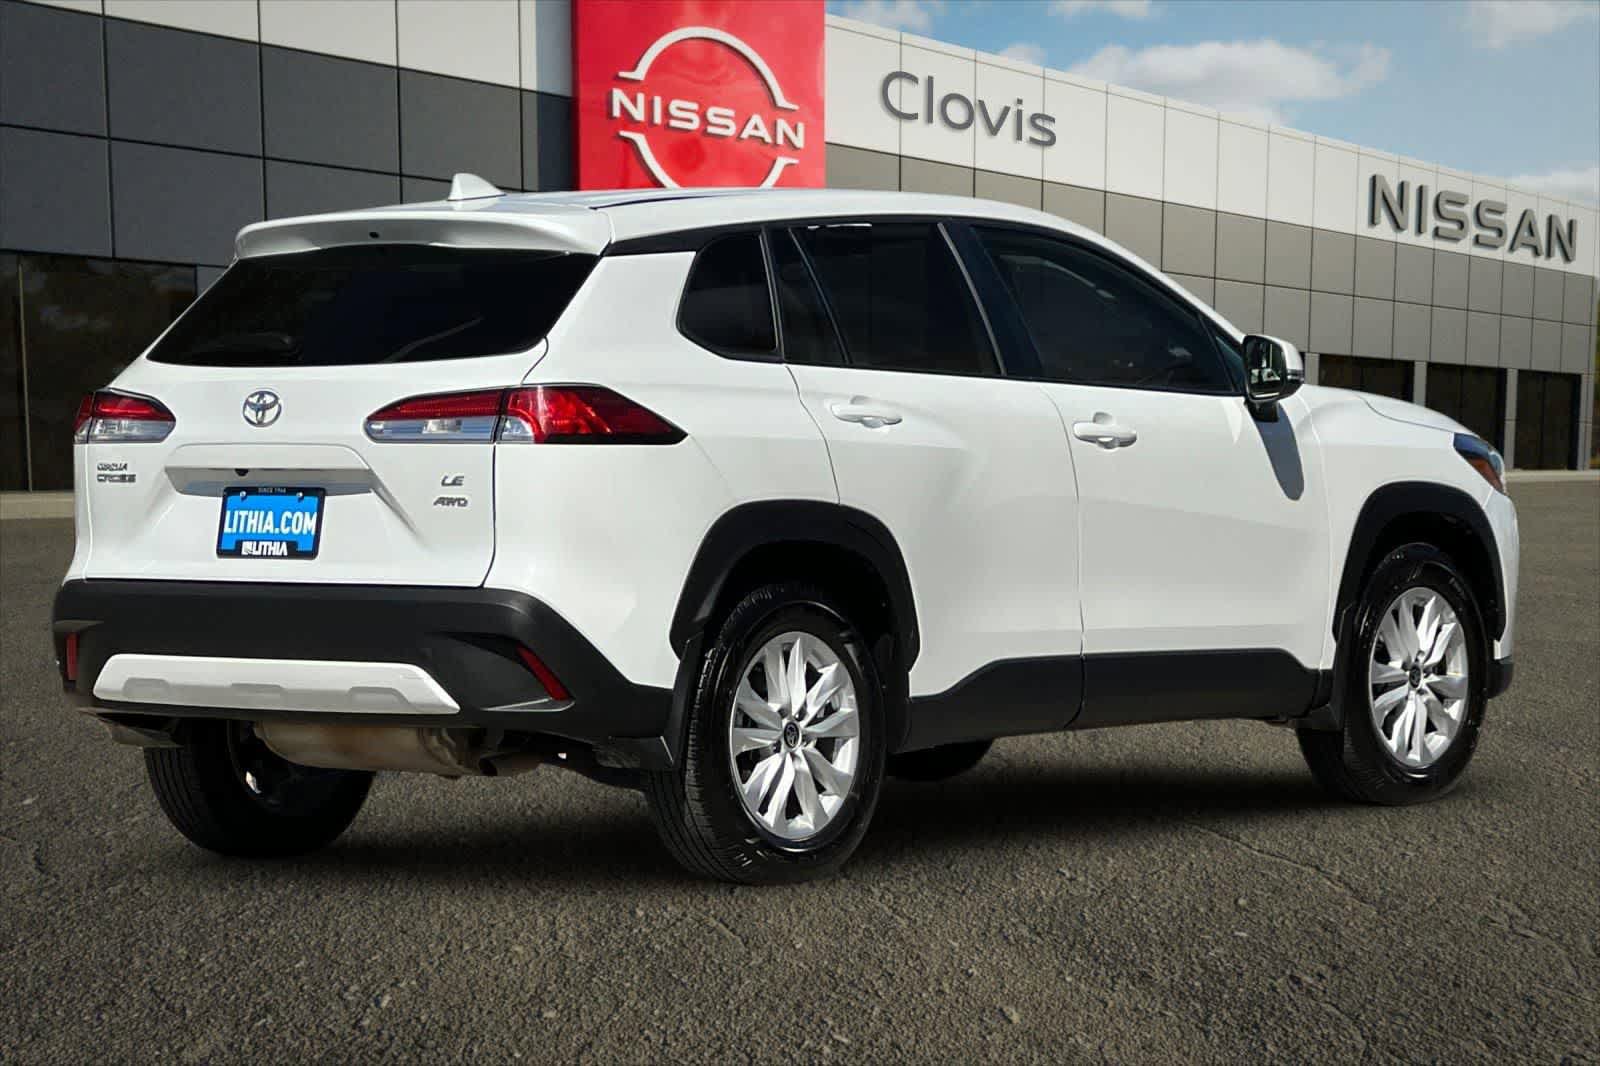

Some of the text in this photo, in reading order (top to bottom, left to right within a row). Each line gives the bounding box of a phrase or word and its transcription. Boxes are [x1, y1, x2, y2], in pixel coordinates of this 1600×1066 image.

[611, 88, 805, 149] NISSAN
[880, 71, 1057, 147] Clovis
[1368, 174, 1578, 263] NISSAN
[441, 476, 464, 486] LE
[433, 497, 468, 507] AWD
[223, 510, 318, 535] LITHIA.COM
[252, 541, 288, 555] LITHIA
